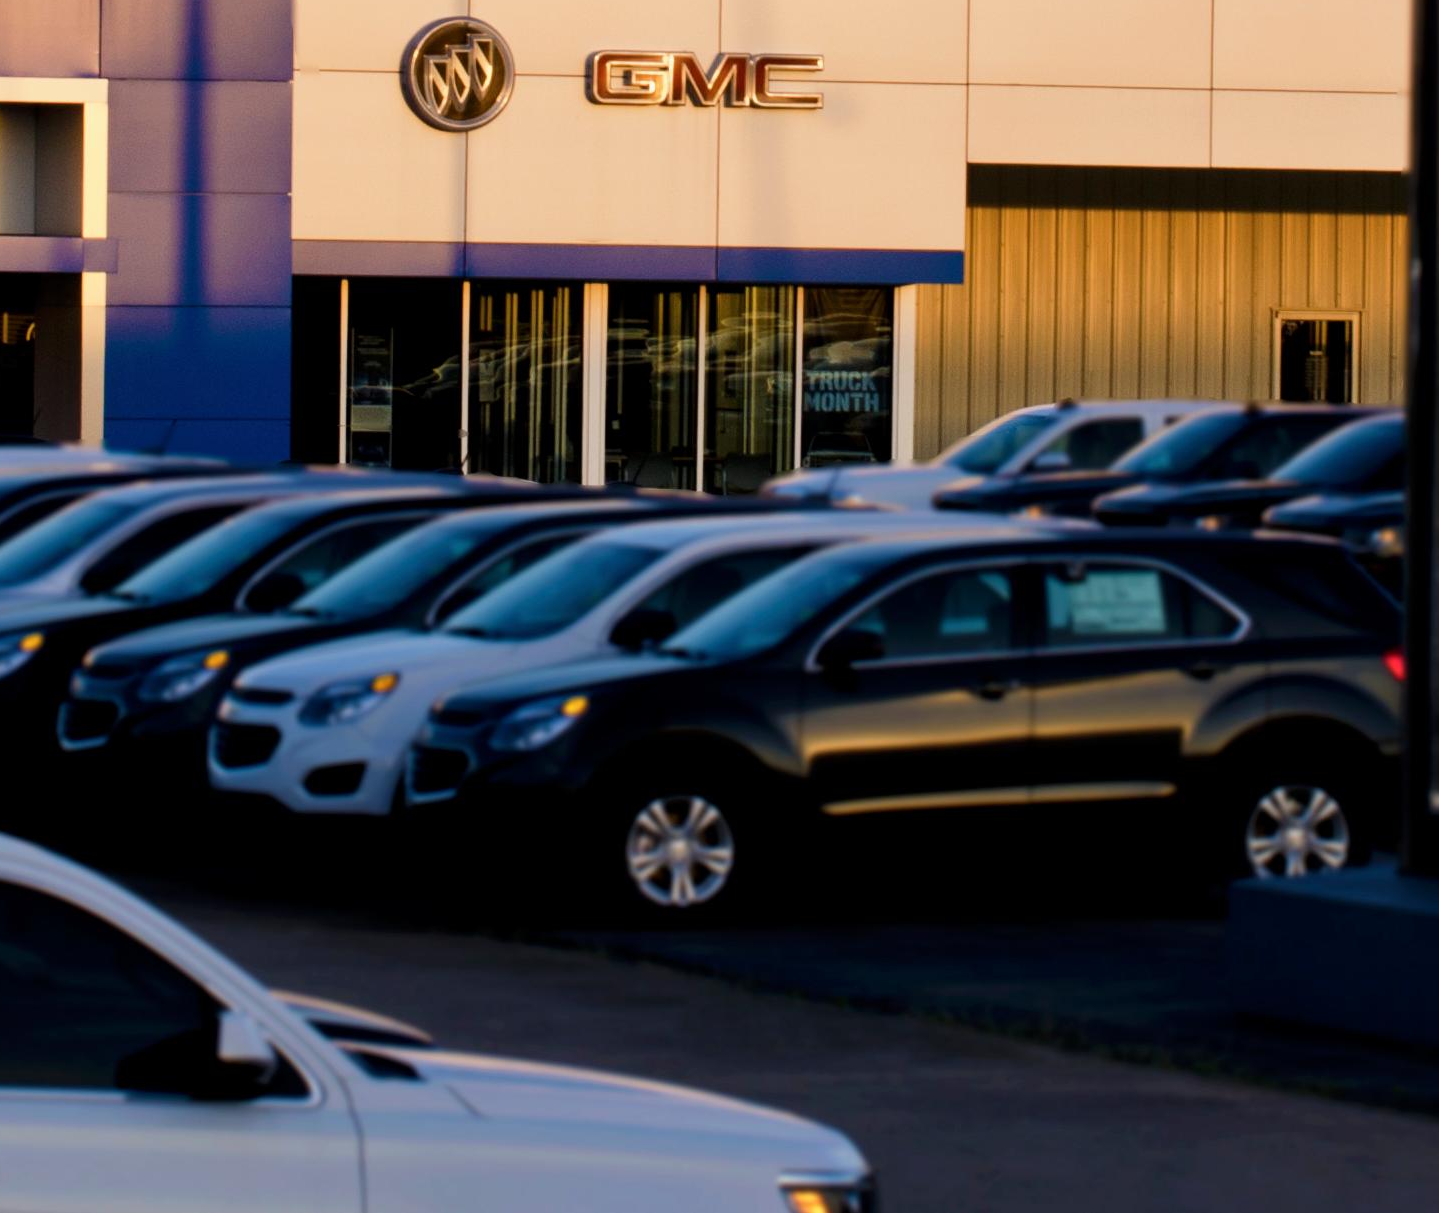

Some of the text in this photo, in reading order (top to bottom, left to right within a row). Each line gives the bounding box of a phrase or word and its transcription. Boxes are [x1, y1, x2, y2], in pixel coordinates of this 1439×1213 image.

[585, 50, 824, 109] GMC
[806, 371, 876, 391] TRUCK
[804, 392, 880, 413] MONTH
